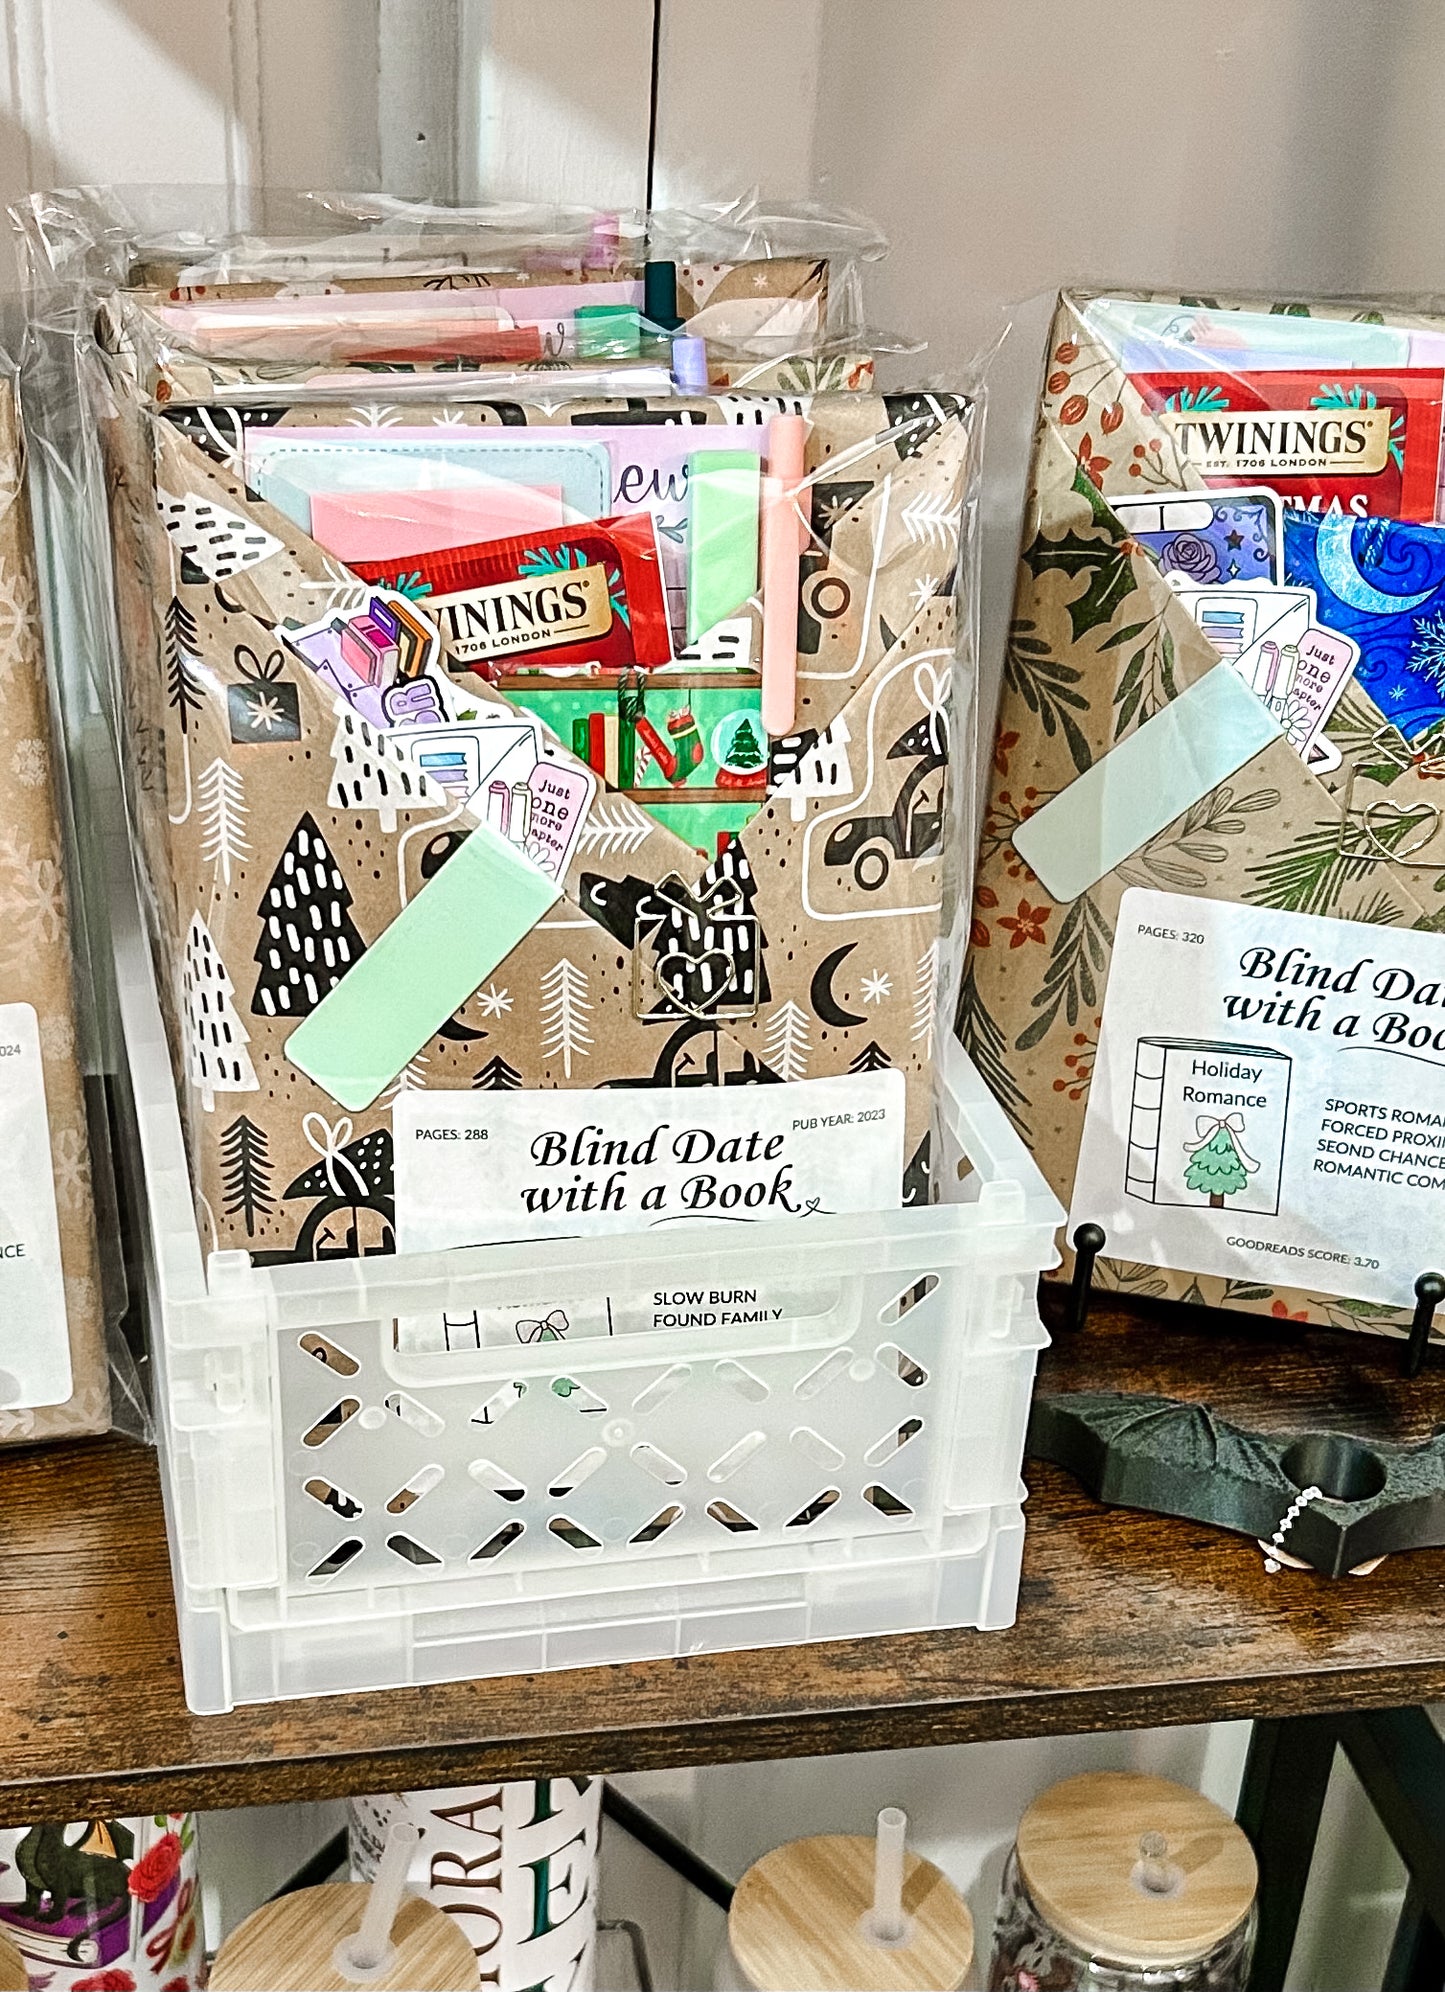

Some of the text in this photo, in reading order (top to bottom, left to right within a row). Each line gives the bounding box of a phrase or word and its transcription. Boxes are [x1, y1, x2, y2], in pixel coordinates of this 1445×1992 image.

[1175, 420, 1367, 455] TWININGS
[1236, 459, 1266, 468] 1706
[1271, 458, 1327, 468] LONDON
[492, 628, 551, 648] LONDON
[1306, 644, 1335, 665] just
[1297, 660, 1330, 683] one
[1292, 687, 1322, 711] apter
[538, 779, 571, 800] just
[531, 796, 570, 820] one
[531, 829, 564, 852] apter
[1137, 924, 1205, 945] PAGES: 320
[1239, 946, 1445, 1008] Blind Da
[1223, 990, 1326, 1031] with
[1332, 1014, 1361, 1038] a
[1191, 1059, 1263, 1083] Holiday
[1183, 1086, 1268, 1108] Romance
[792, 1108, 886, 1131] PUB YEAR: 2023
[1324, 1098, 1445, 1131] SPORTS ROMA
[415, 1129, 488, 1141] PAGES: 288
[530, 1124, 785, 1167] Blind Date
[1321, 1118, 1445, 1150] FORCED PROXI
[1316, 1138, 1375, 1159] SEOND
[1313, 1159, 1404, 1185] ROMANTIC
[520, 1163, 802, 1214] with a Book
[1226, 1236, 1380, 1270] GOODREADS SCORE: 3.70
[653, 1289, 756, 1305] SLOW BURN
[653, 1313, 716, 1327] FOUND
